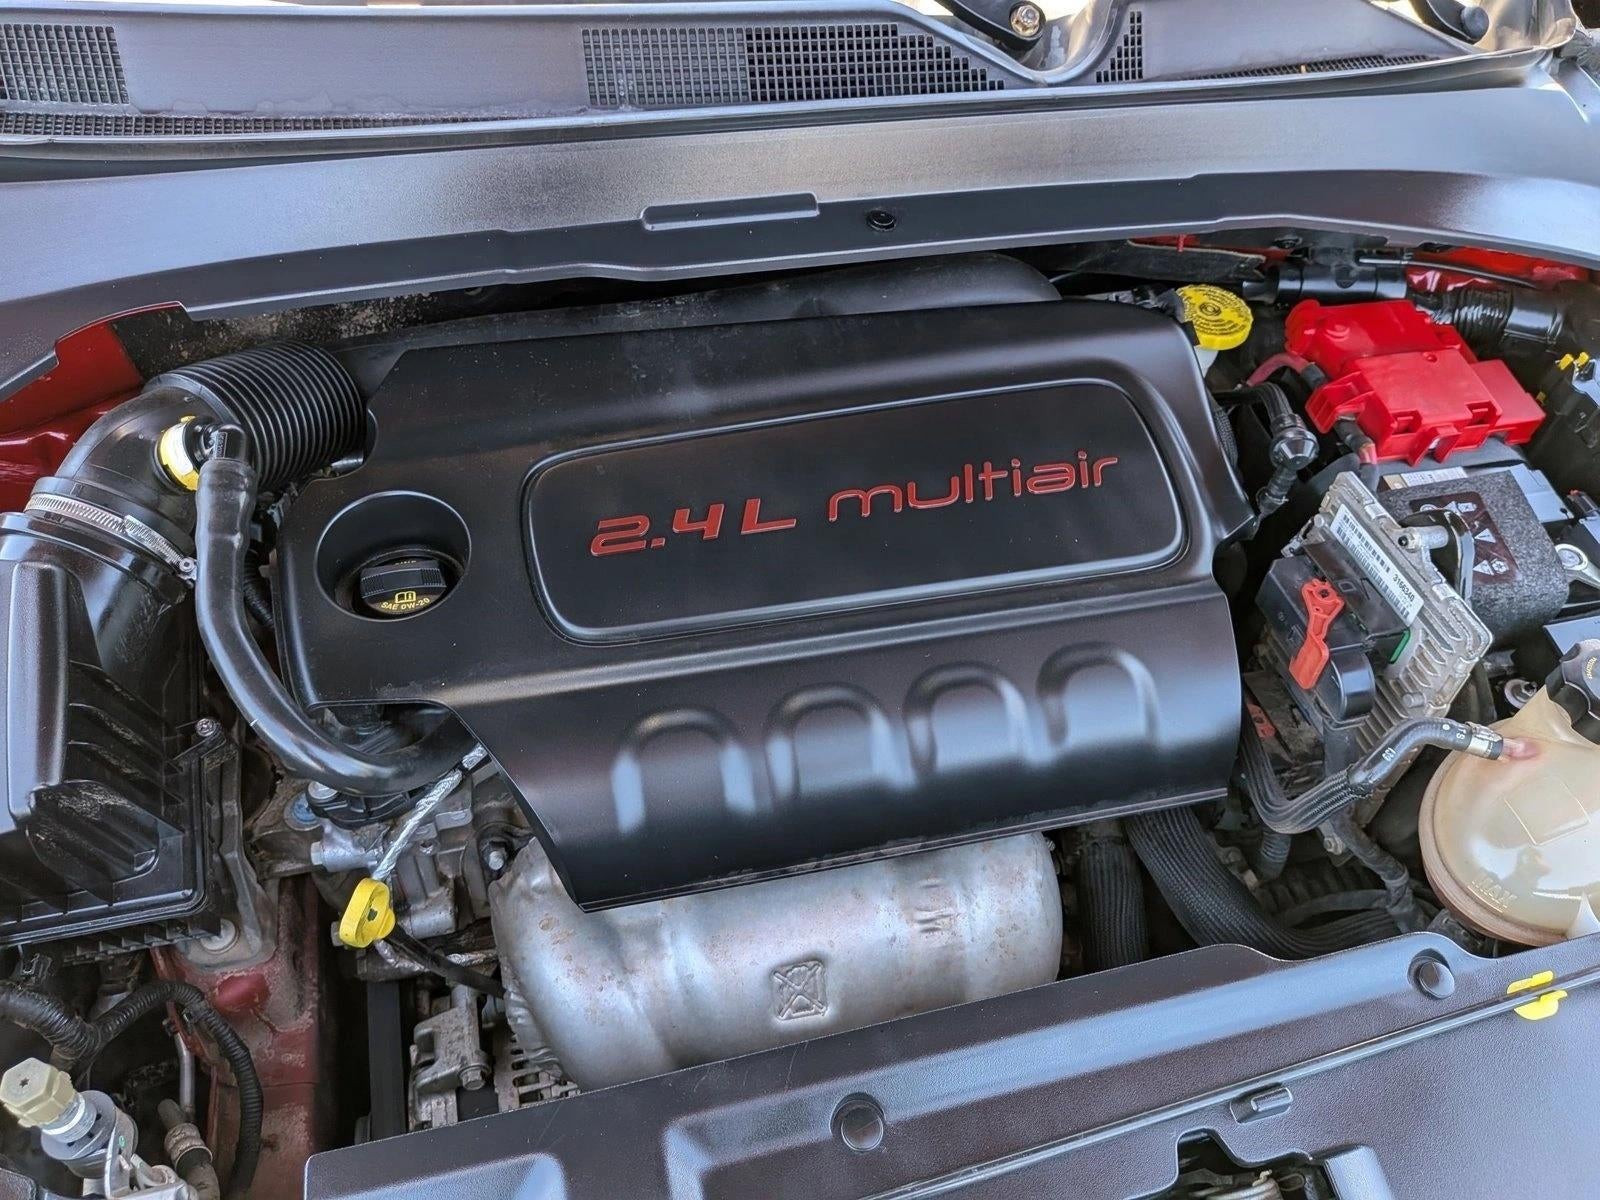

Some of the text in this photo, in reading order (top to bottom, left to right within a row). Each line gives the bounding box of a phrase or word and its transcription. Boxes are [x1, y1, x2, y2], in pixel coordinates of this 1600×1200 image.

[828, 450, 1119, 522] multiair
[381, 597, 430, 610] SAE 0W-20
